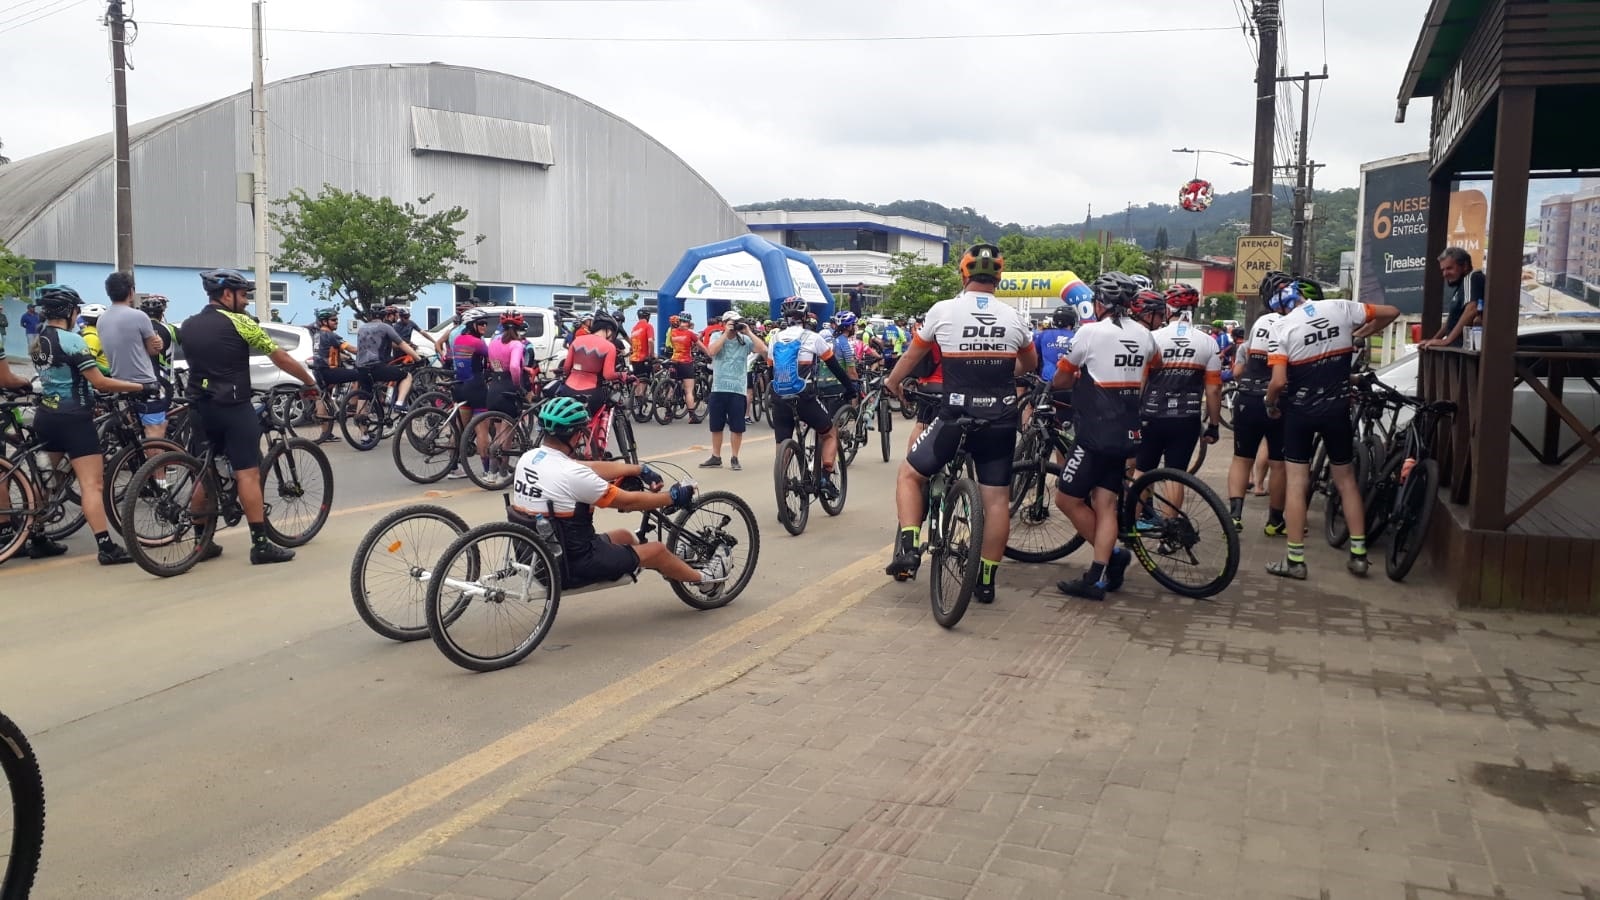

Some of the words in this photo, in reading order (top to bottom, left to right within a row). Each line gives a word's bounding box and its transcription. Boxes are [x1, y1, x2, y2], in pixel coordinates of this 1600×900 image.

[1373, 201, 1392, 239] 6
[1393, 213, 1416, 225] PARA
[1416, 212, 1424, 222] A
[1246, 261, 1271, 270] PARE
[714, 279, 762, 287] CIGAMVALI
[1031, 279, 1051, 290] FM
[962, 326, 1006, 338] DLB
[1304, 326, 1340, 346] DLB
[1163, 348, 1196, 358] DLB
[1114, 354, 1144, 367] DLB
[1062, 445, 1086, 483] STRAY
[515, 480, 543, 498] DLB
